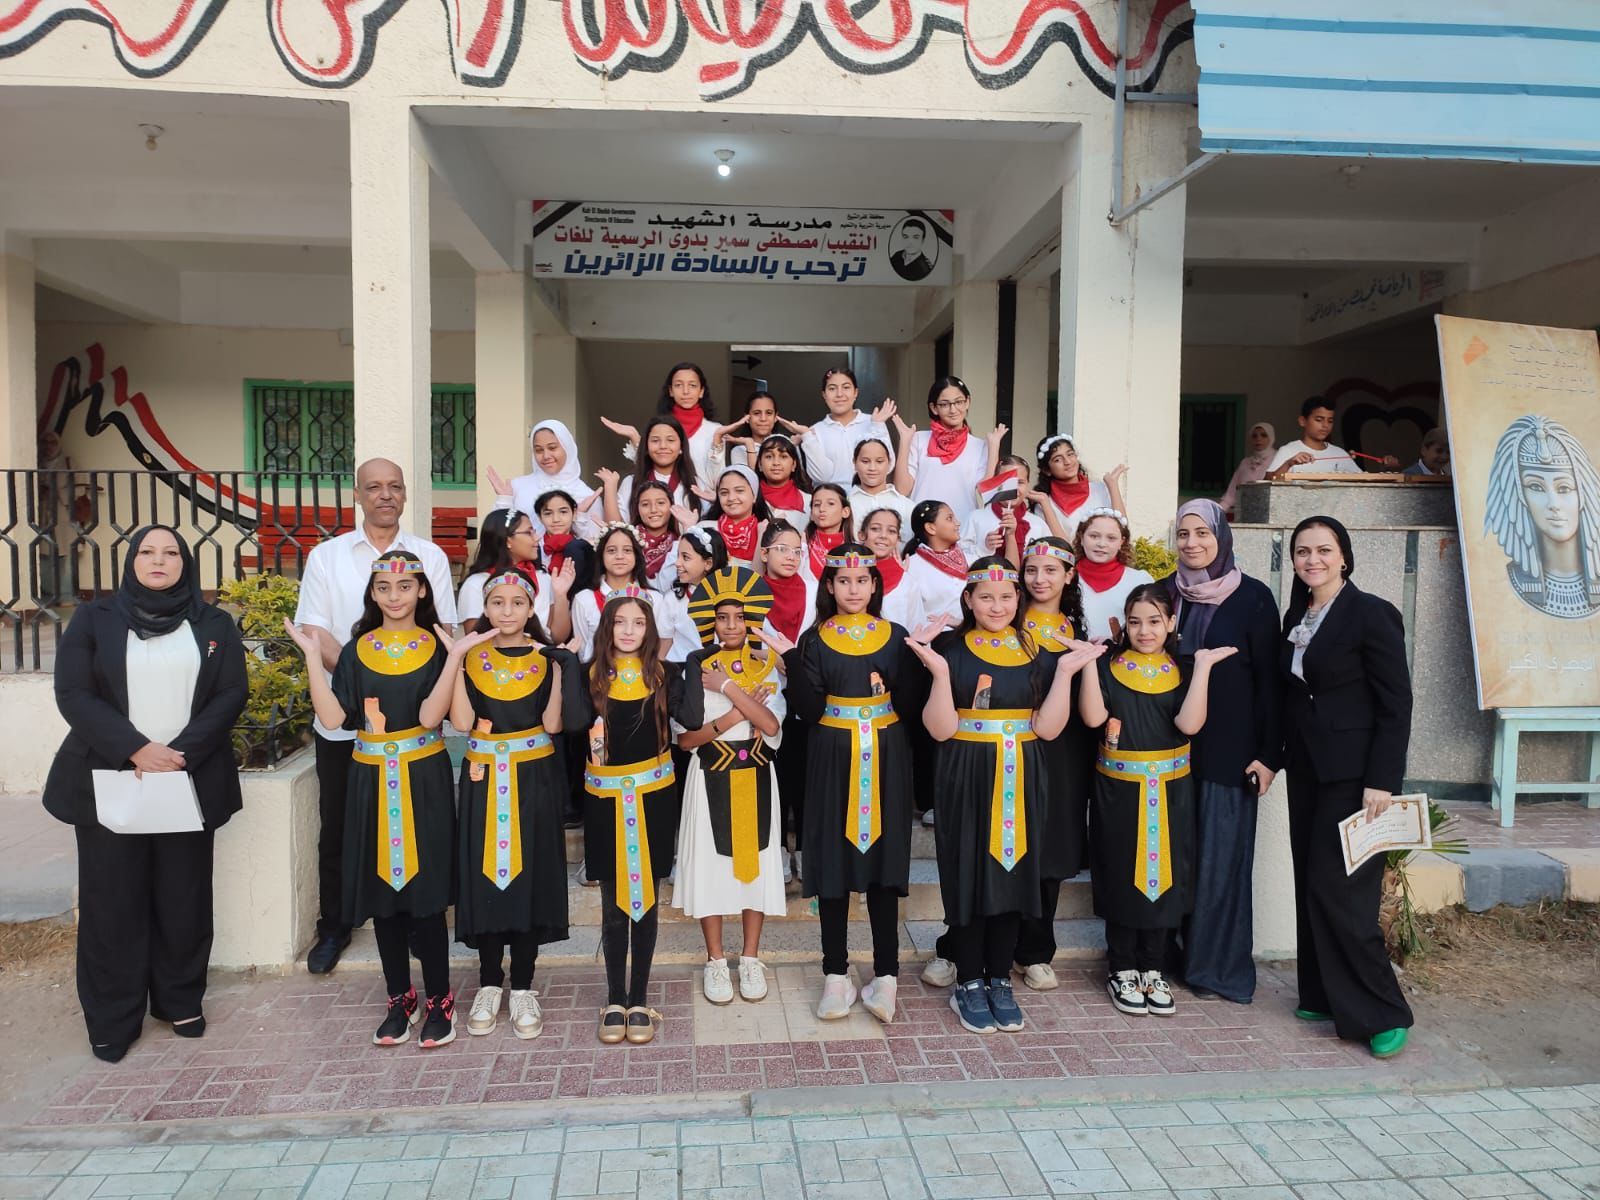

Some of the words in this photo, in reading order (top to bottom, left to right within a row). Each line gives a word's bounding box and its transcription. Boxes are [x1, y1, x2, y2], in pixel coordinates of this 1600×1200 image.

[648, 209, 735, 229] الشهيد
[747, 213, 833, 231] مدرسة
[554, 225, 593, 243] للغات
[601, 226, 662, 249] الرسمية
[563, 249, 665, 276] الزائرين
[671, 252, 779, 279] بالسادة
[784, 256, 867, 281] ترحب
